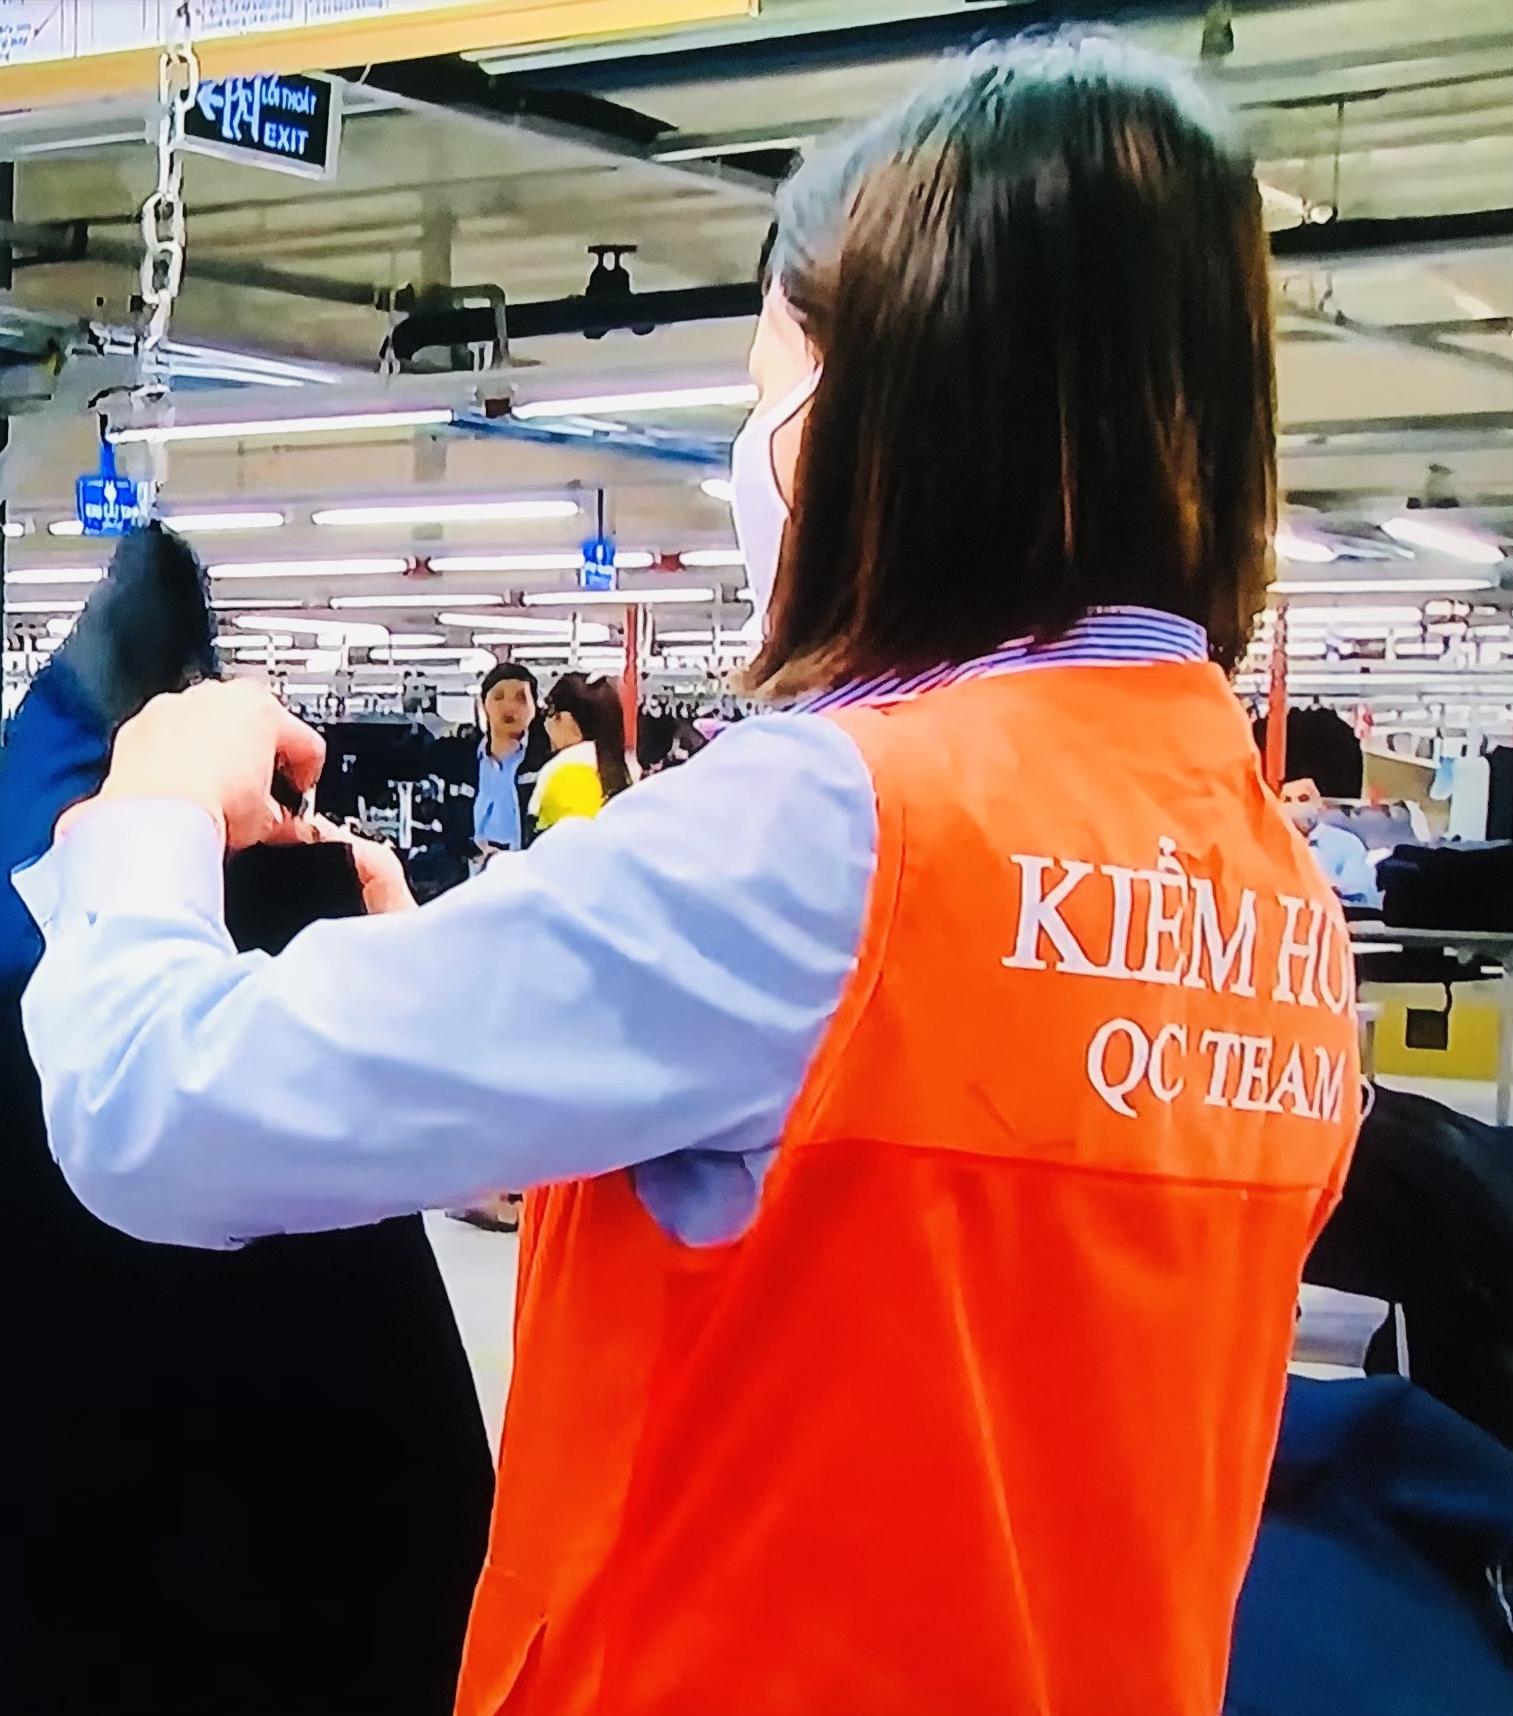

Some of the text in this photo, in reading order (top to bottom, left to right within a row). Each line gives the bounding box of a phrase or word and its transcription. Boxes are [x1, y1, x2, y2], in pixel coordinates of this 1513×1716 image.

[264, 122, 309, 155] EXIT
[1001, 835, 1257, 997] KIỂM
[1087, 1017, 1347, 1123] QC TEAM
